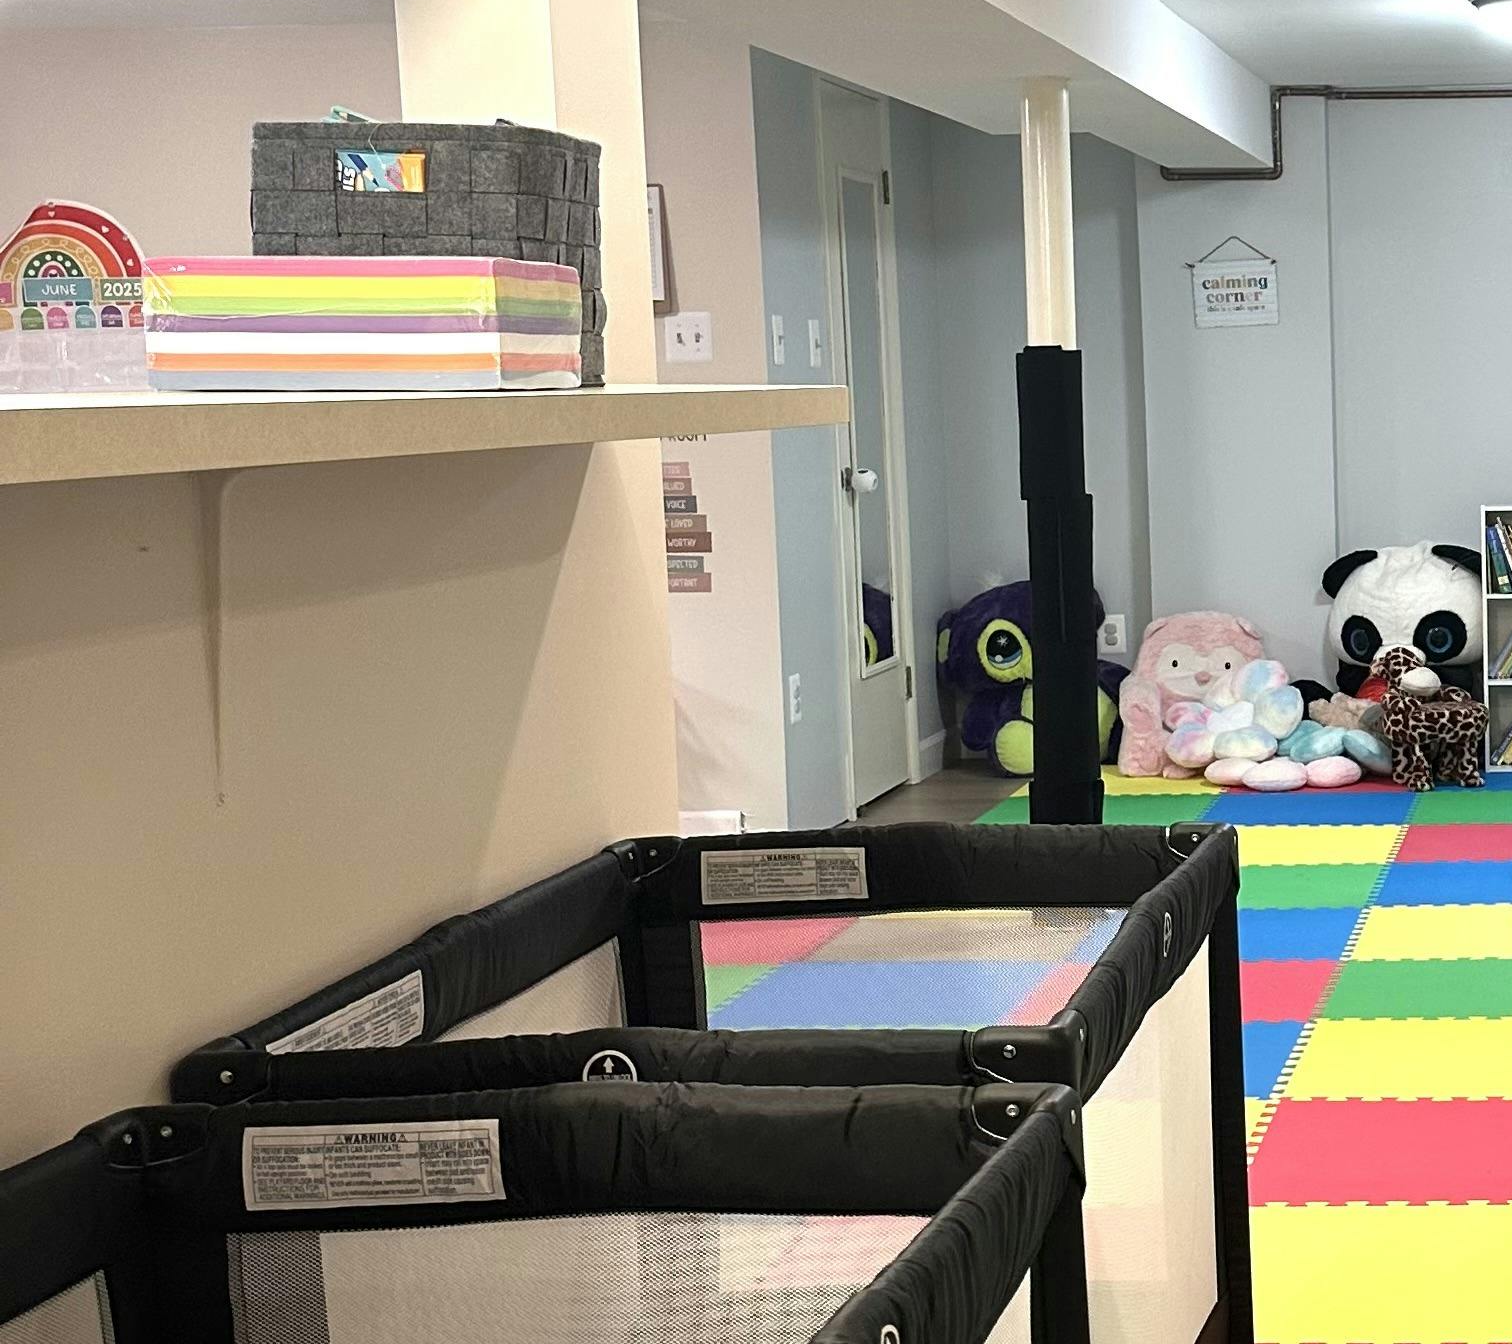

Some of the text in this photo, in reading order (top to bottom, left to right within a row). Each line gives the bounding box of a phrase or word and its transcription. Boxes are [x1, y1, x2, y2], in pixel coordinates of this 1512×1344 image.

[1202, 275, 1268, 290] calming
[41, 283, 78, 296] JUNE
[103, 283, 143, 296] 2025
[1206, 291, 1263, 304] corner
[666, 500, 686, 509] VOICE
[670, 518, 693, 528] LOVED
[667, 538, 696, 547] WORTHY
[344, 1133, 397, 1144] WARNING
